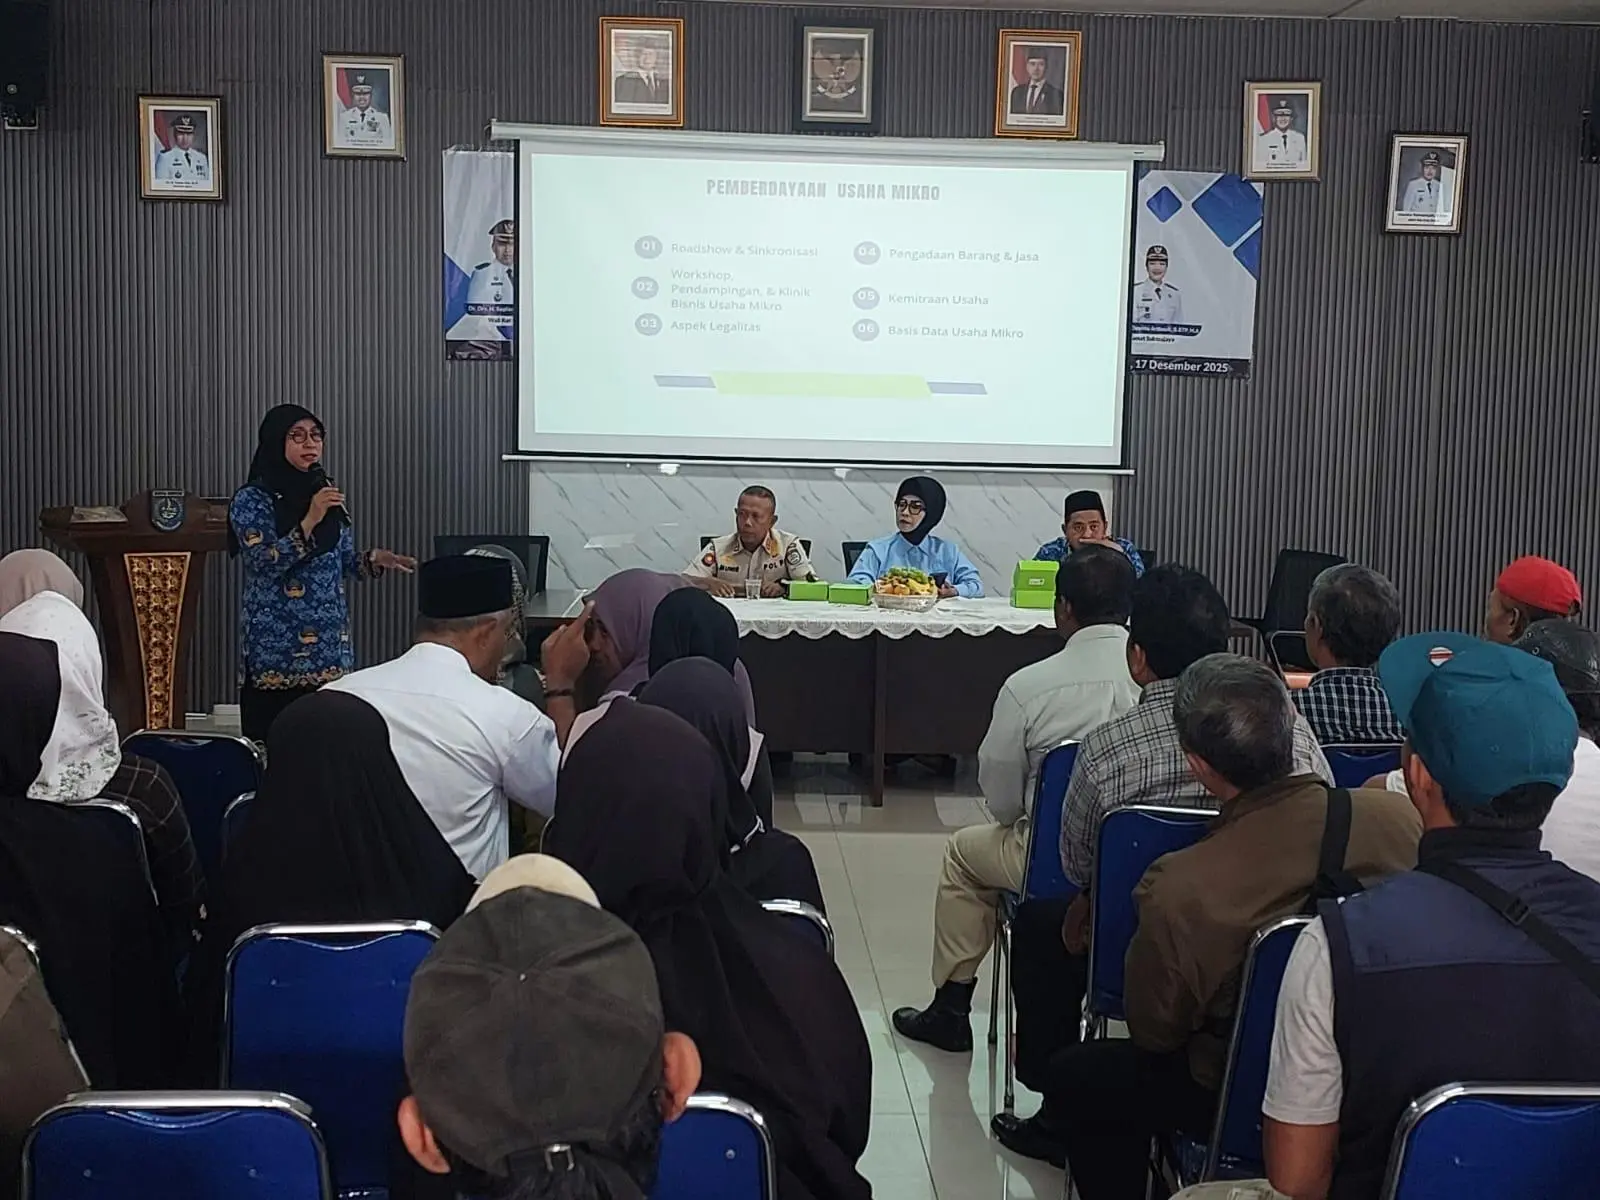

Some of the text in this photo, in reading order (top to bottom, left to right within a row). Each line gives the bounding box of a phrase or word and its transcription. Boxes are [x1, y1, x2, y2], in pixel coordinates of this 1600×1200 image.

[706, 179, 941, 201] PEMBERDAYAAN USAHA MIKRO
[641, 239, 657, 251] 01
[671, 243, 819, 257] Roadshow & Sinkronisasi
[857, 246, 877, 257] 04
[889, 248, 1040, 263] Pengadaan Barang & Jasa
[671, 268, 734, 282] Workshop,
[635, 281, 653, 292] 02
[671, 284, 811, 297] Pendampingan, & Klinik
[857, 290, 876, 300] 05
[888, 293, 989, 305] Kemitraan Usaha
[671, 299, 783, 311] Bisnis Usaha Mikro
[670, 321, 761, 334] Aspek Legalitas
[857, 322, 875, 333] 06
[888, 325, 1024, 339] Basis Data Usaha Mikro
[1135, 359, 1229, 372] 17 Desember 2025
